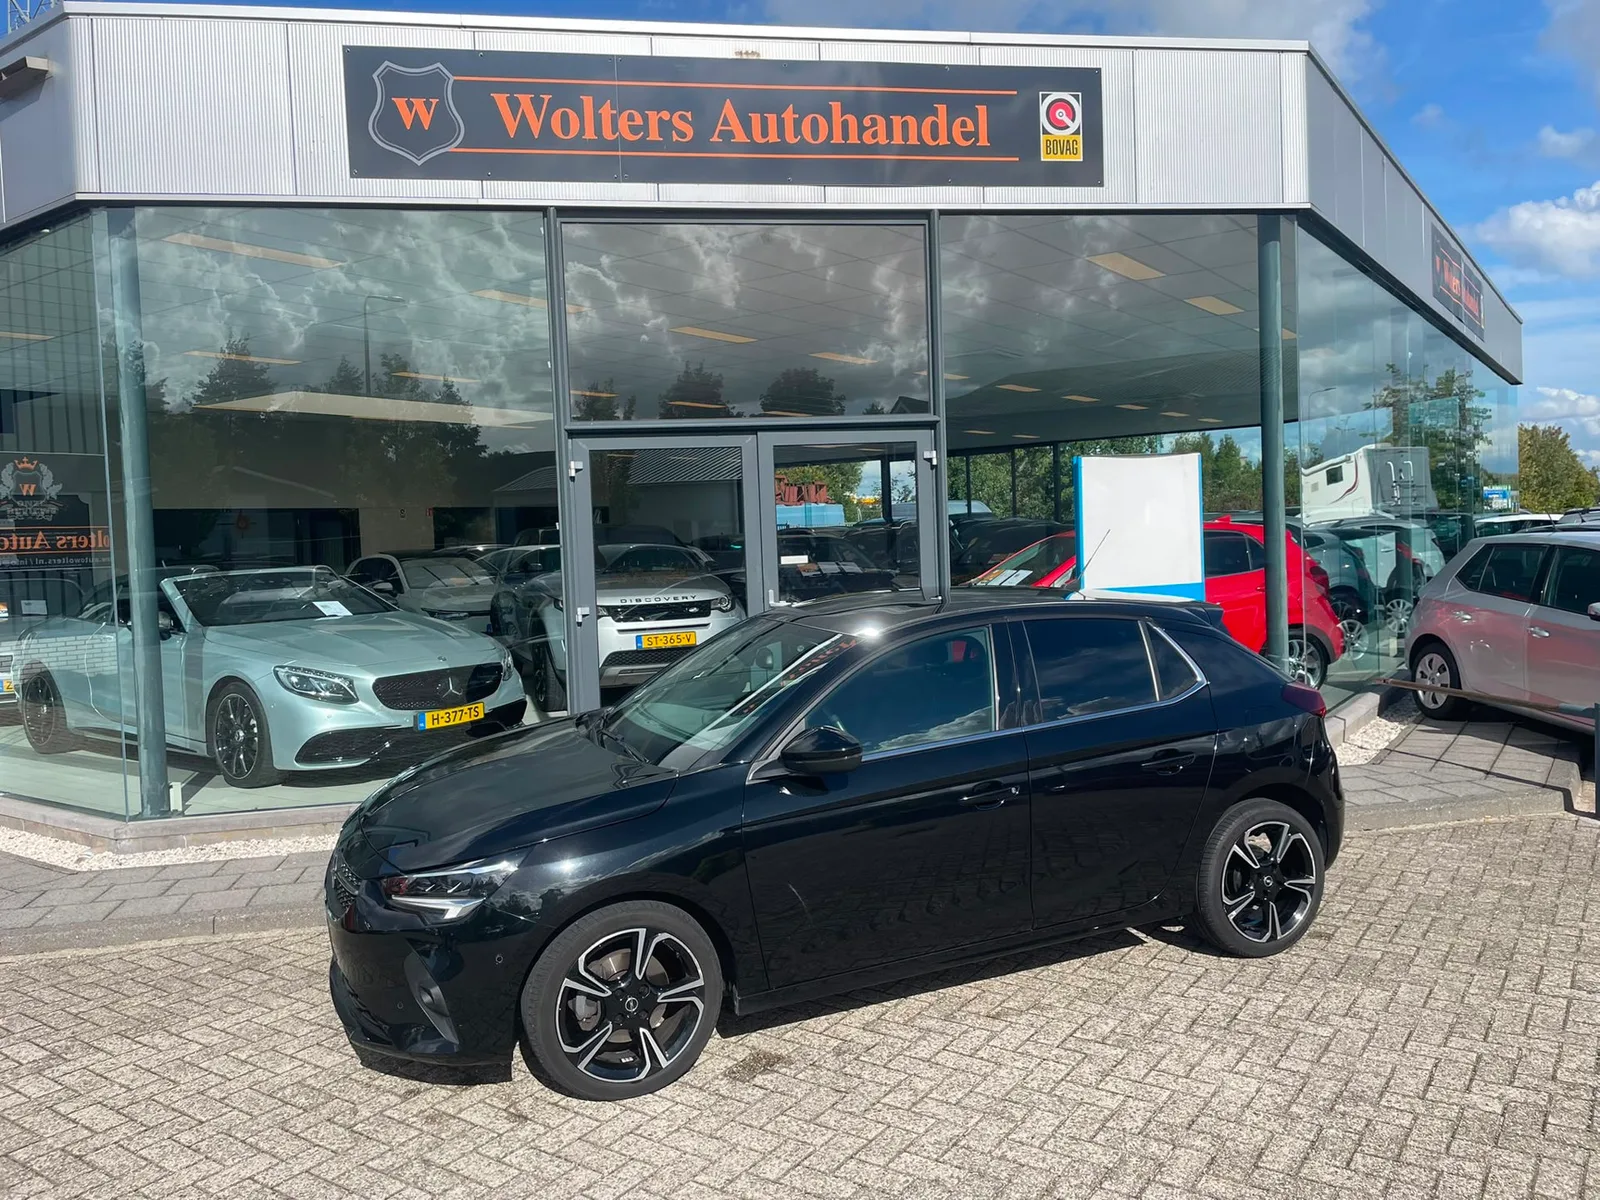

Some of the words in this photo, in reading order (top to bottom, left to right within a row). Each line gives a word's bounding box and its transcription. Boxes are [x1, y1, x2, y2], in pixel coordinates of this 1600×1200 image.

[392, 97, 439, 130] W
[490, 93, 694, 143] Wolters
[709, 98, 990, 147] Autohandel
[1045, 138, 1078, 156] BOVAG
[620, 594, 698, 604] DISCOVERY
[646, 633, 692, 646] ST-365-V
[431, 705, 480, 726] H-377-TS
